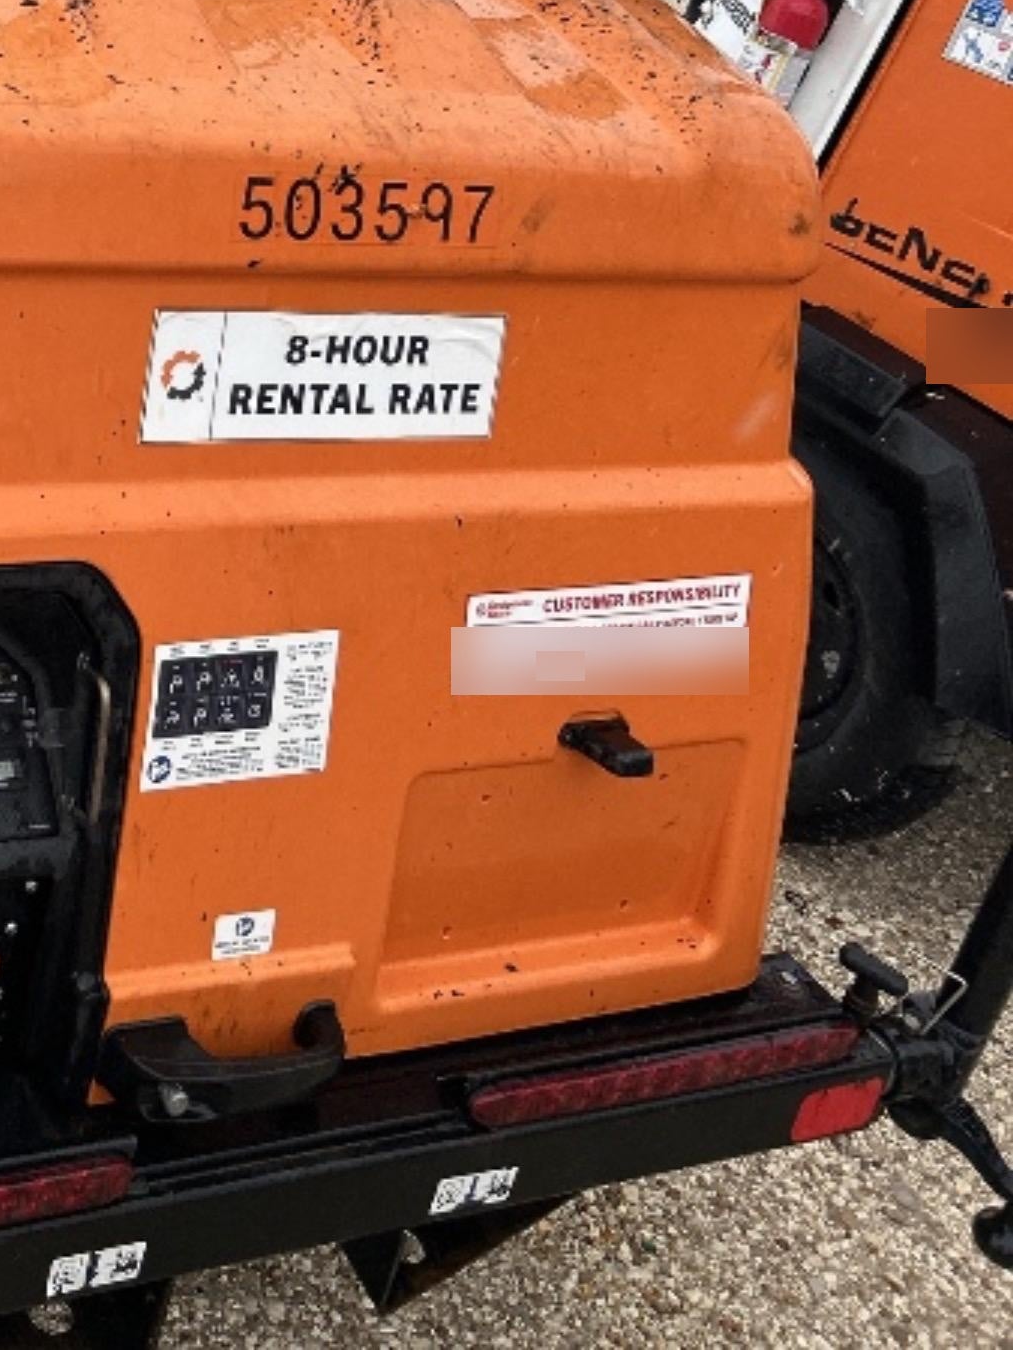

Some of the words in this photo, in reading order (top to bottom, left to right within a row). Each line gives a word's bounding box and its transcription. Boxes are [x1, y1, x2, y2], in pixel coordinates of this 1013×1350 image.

[239, 174, 494, 243] 503597
[285, 334, 430, 367] 8-HOUR
[227, 382, 376, 416] RENTAL
[387, 382, 481, 416] RATE
[542, 593, 624, 613] CUSTOMER
[627, 583, 742, 607] RESPONSIBILITY
